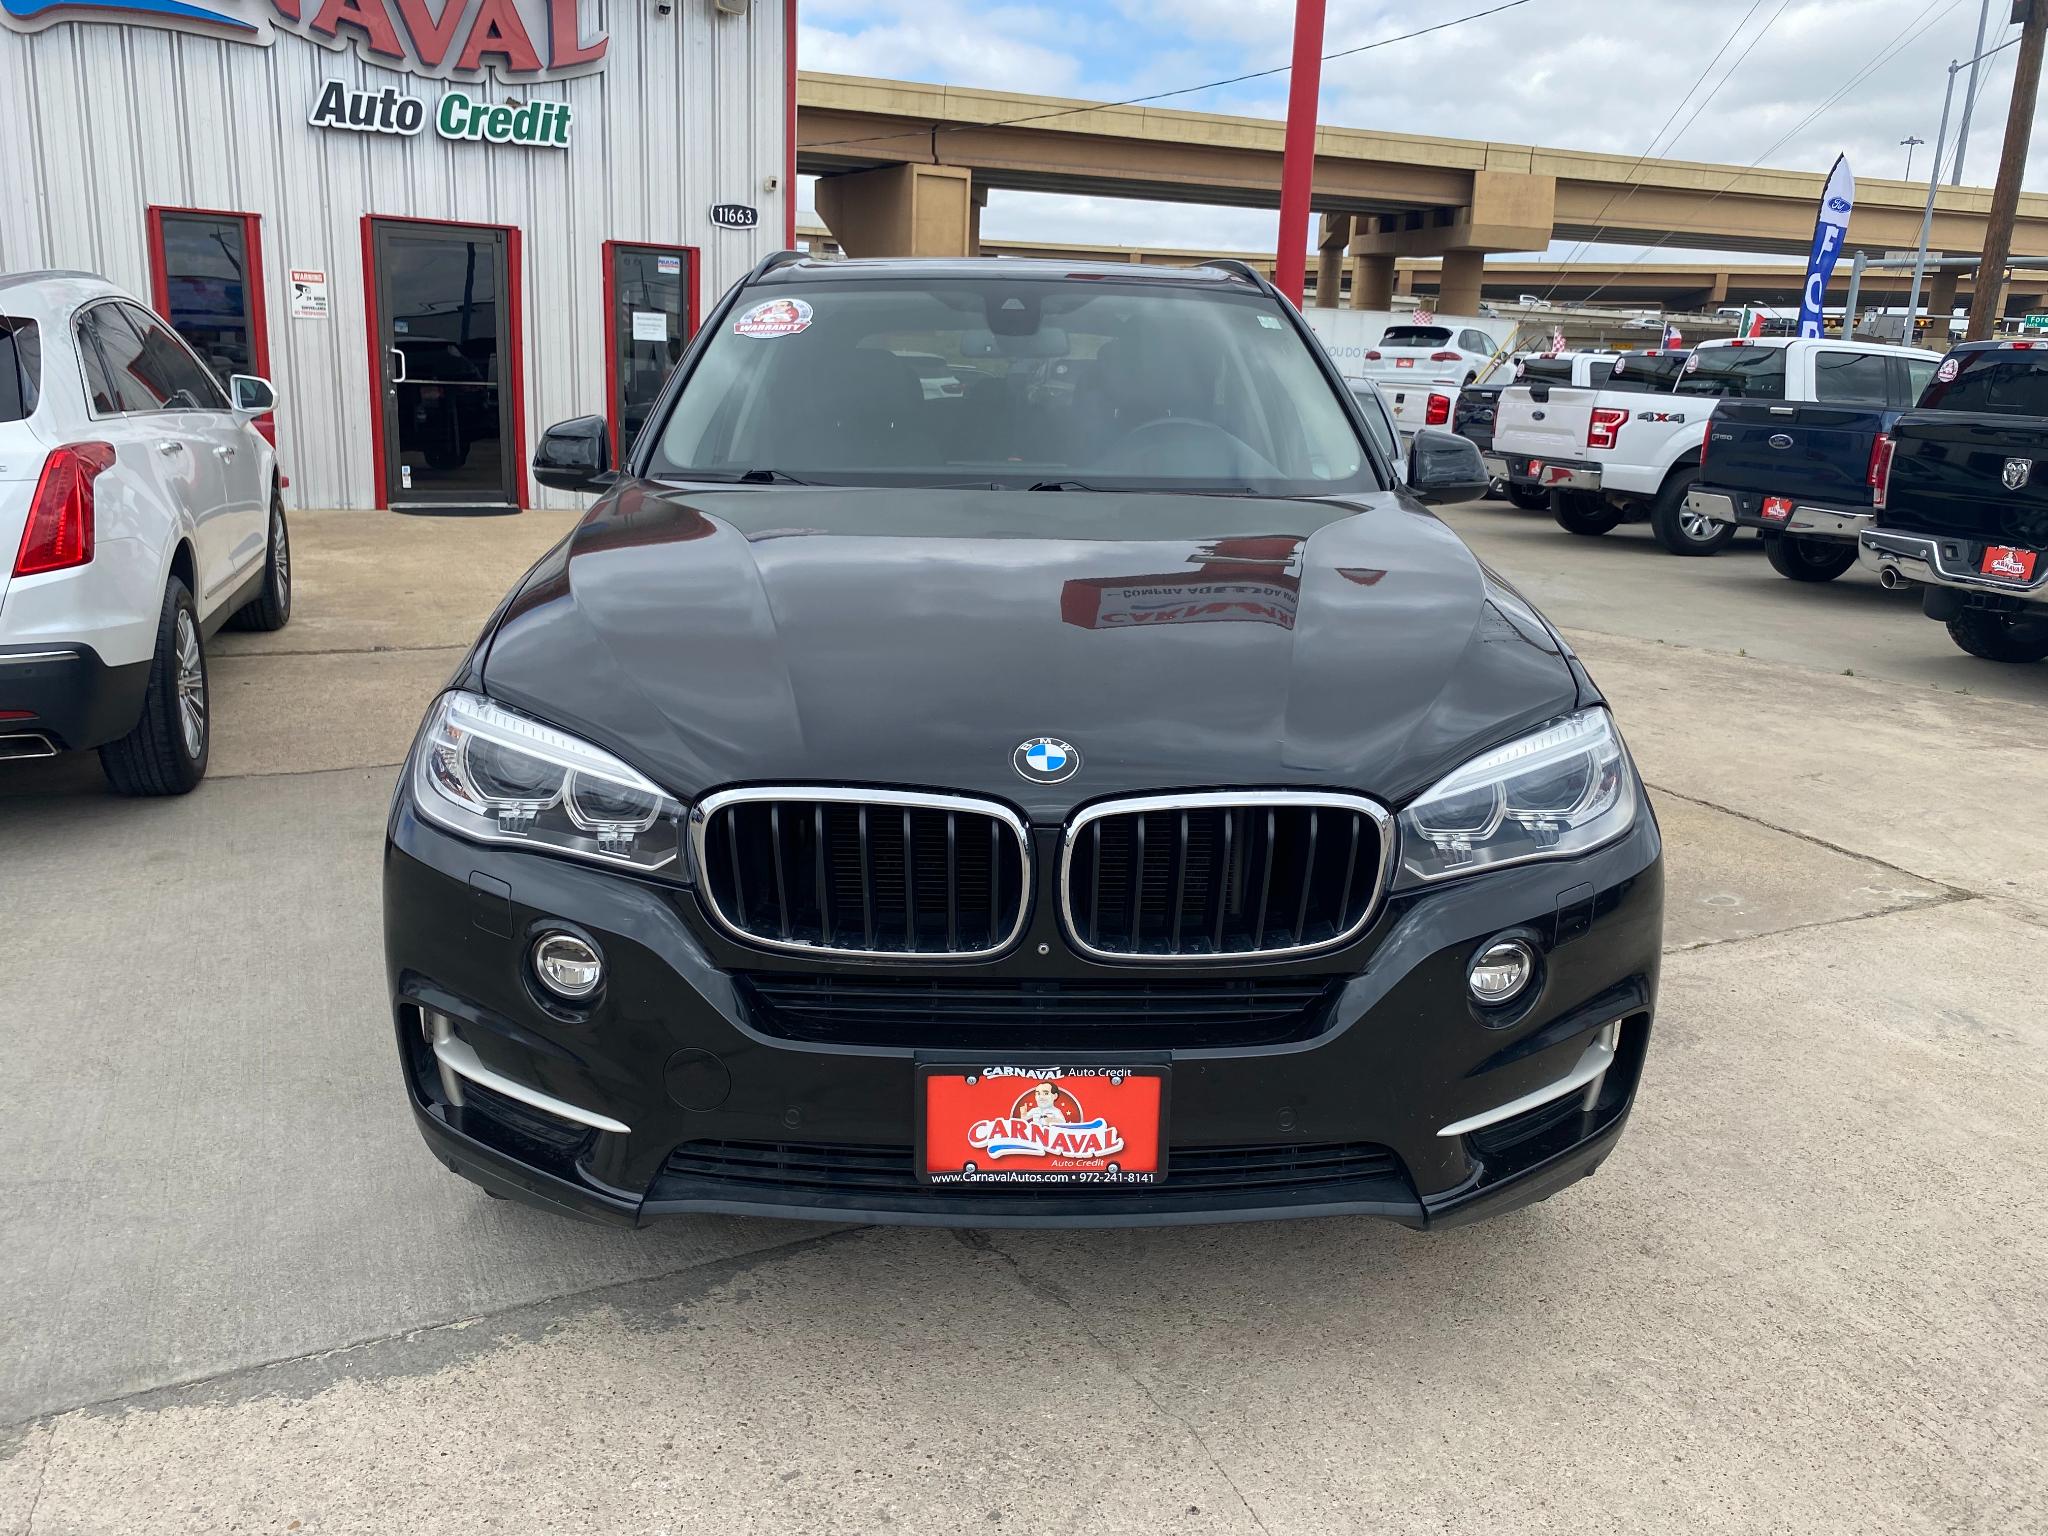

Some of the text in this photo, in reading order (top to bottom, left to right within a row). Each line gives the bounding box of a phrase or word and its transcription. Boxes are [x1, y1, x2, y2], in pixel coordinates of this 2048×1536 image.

[313, 82, 572, 144] Auto Credit
[718, 207, 752, 224] 11663
[740, 324, 801, 332] WARRANTY
[1020, 738, 1073, 751] BMW
[983, 1066, 1132, 1080] CARNAVAL Auto Credit
[968, 1120, 1123, 1154] CARNAVAL
[931, 1171, 1154, 1183] www.CarnavalAutos.com 972-241-8141
